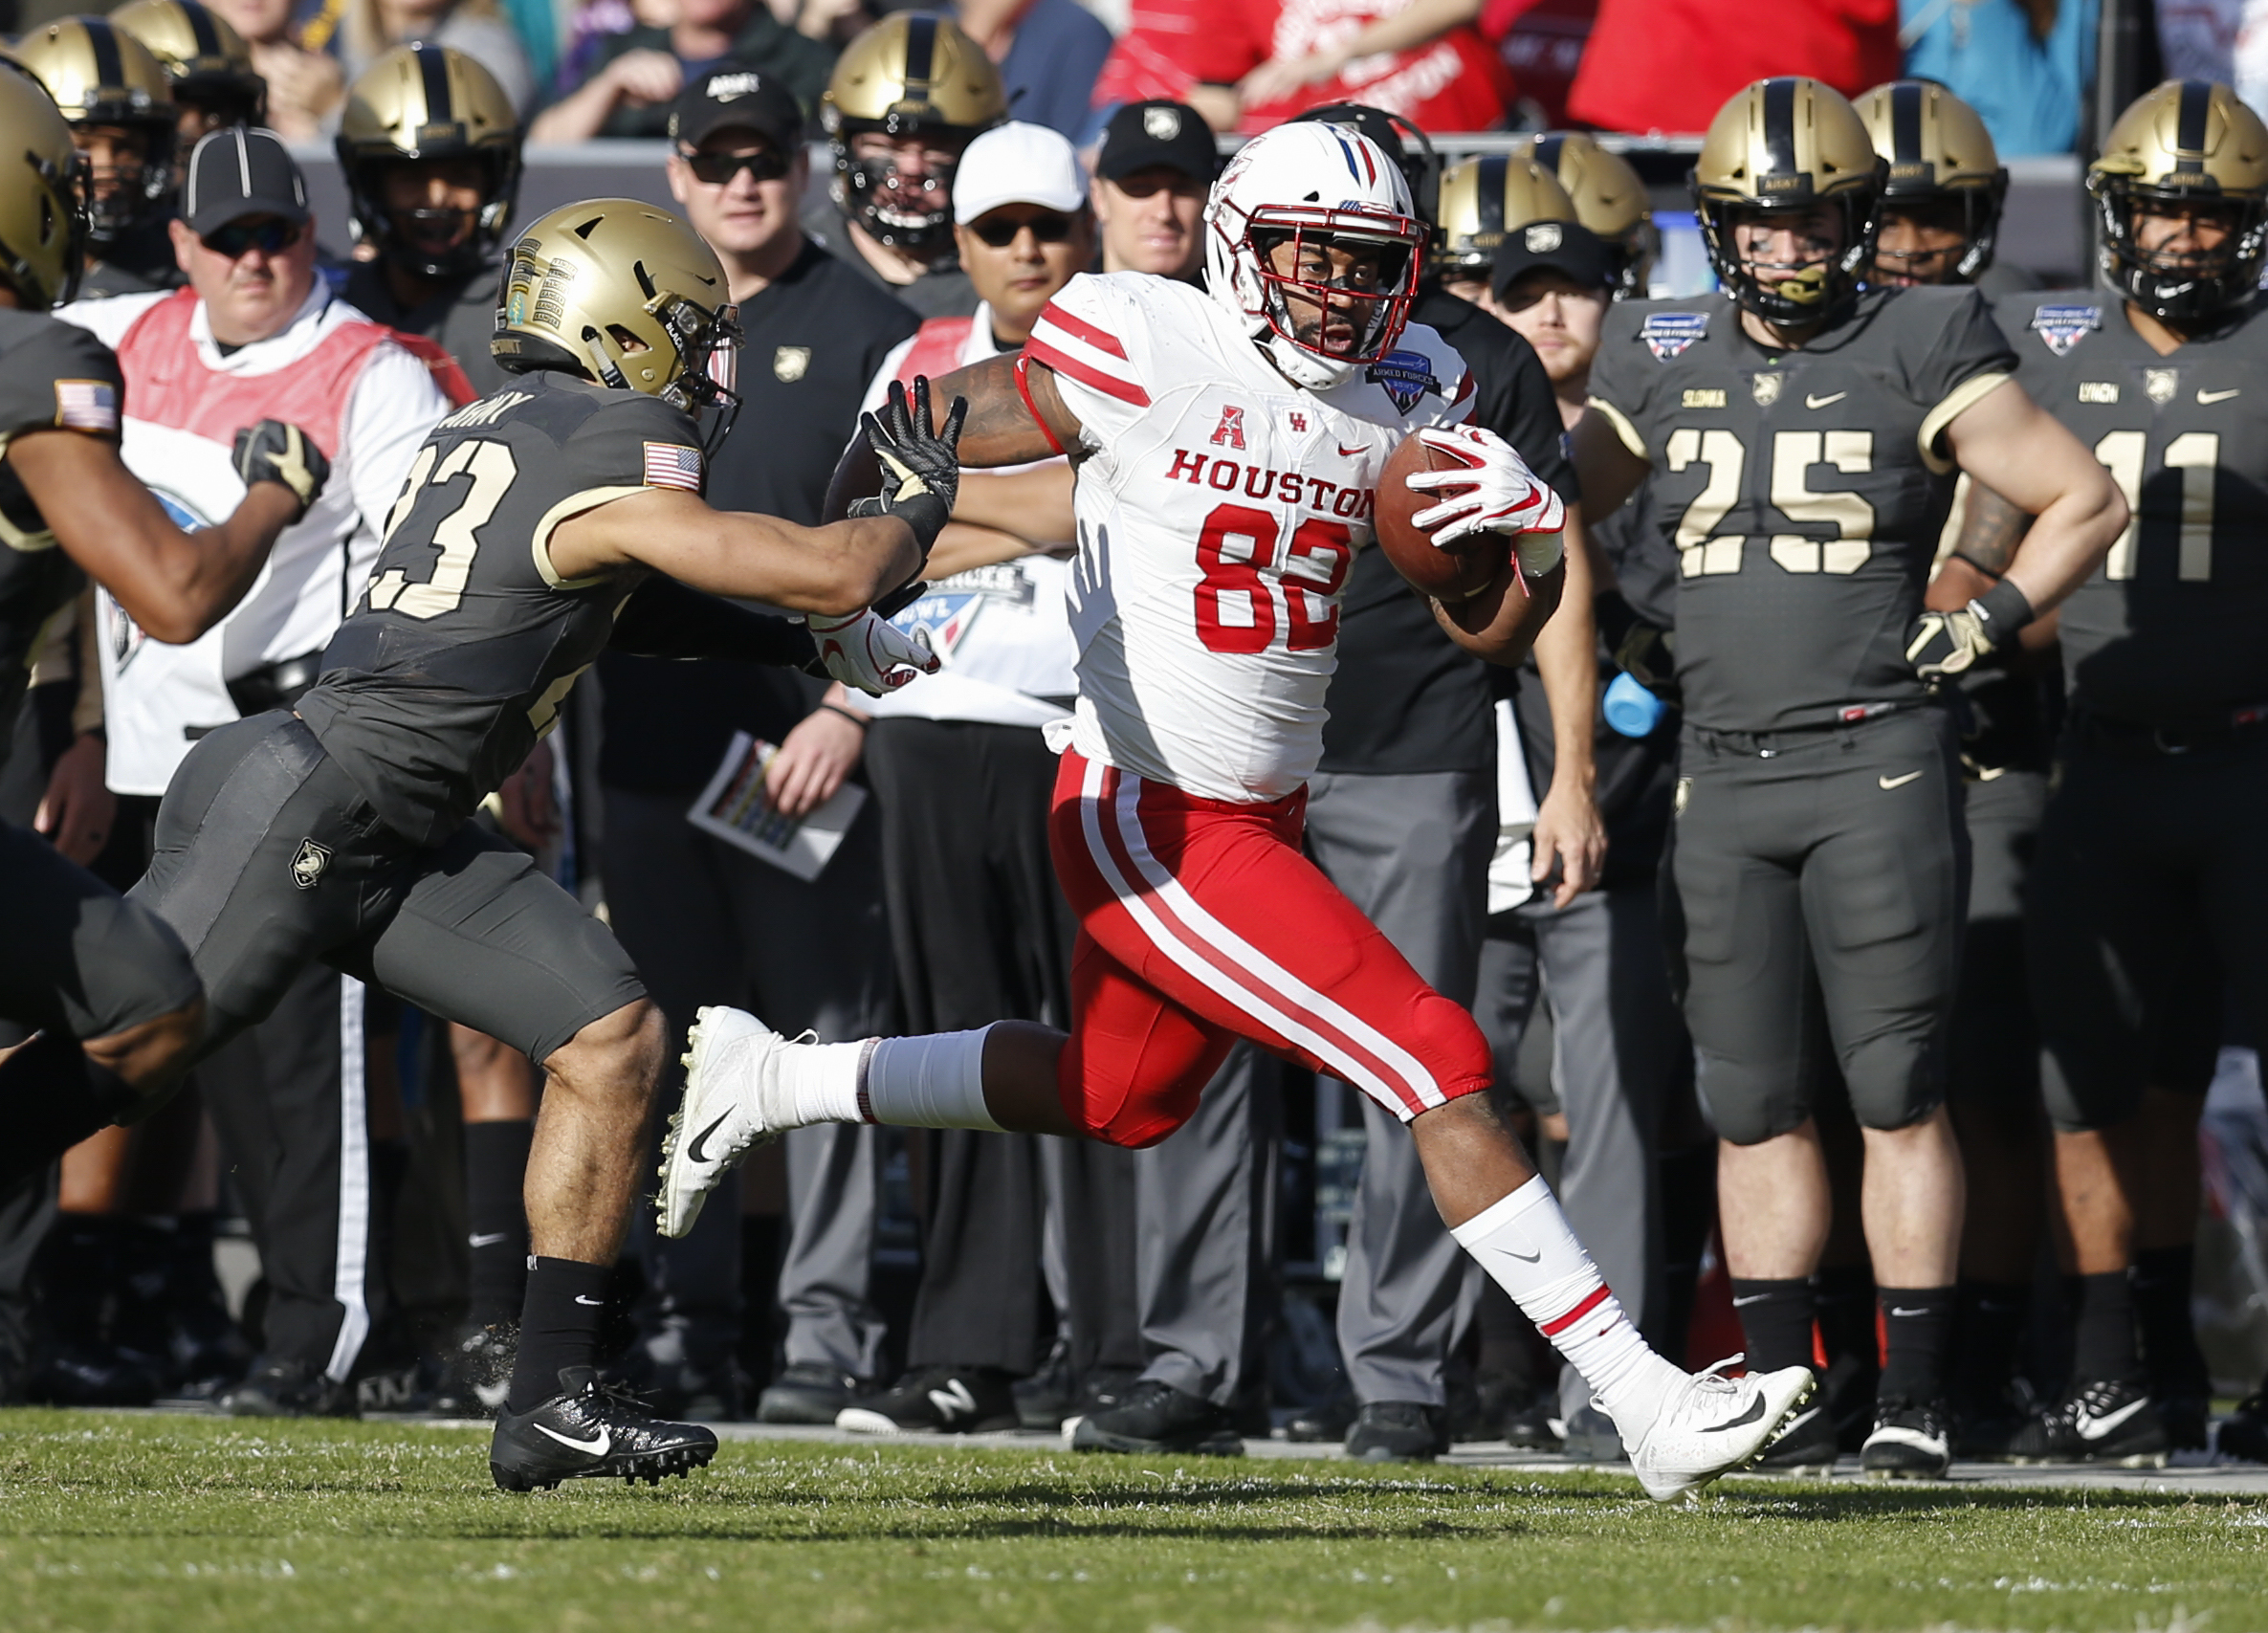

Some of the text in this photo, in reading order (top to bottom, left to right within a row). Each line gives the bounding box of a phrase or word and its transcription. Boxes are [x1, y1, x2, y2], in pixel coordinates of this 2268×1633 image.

[1373, 367, 1434, 386] ARMED FORCES
[1193, 502, 1353, 655] 82
[1664, 428, 1876, 580] 25
[2094, 430, 2220, 582] 11
